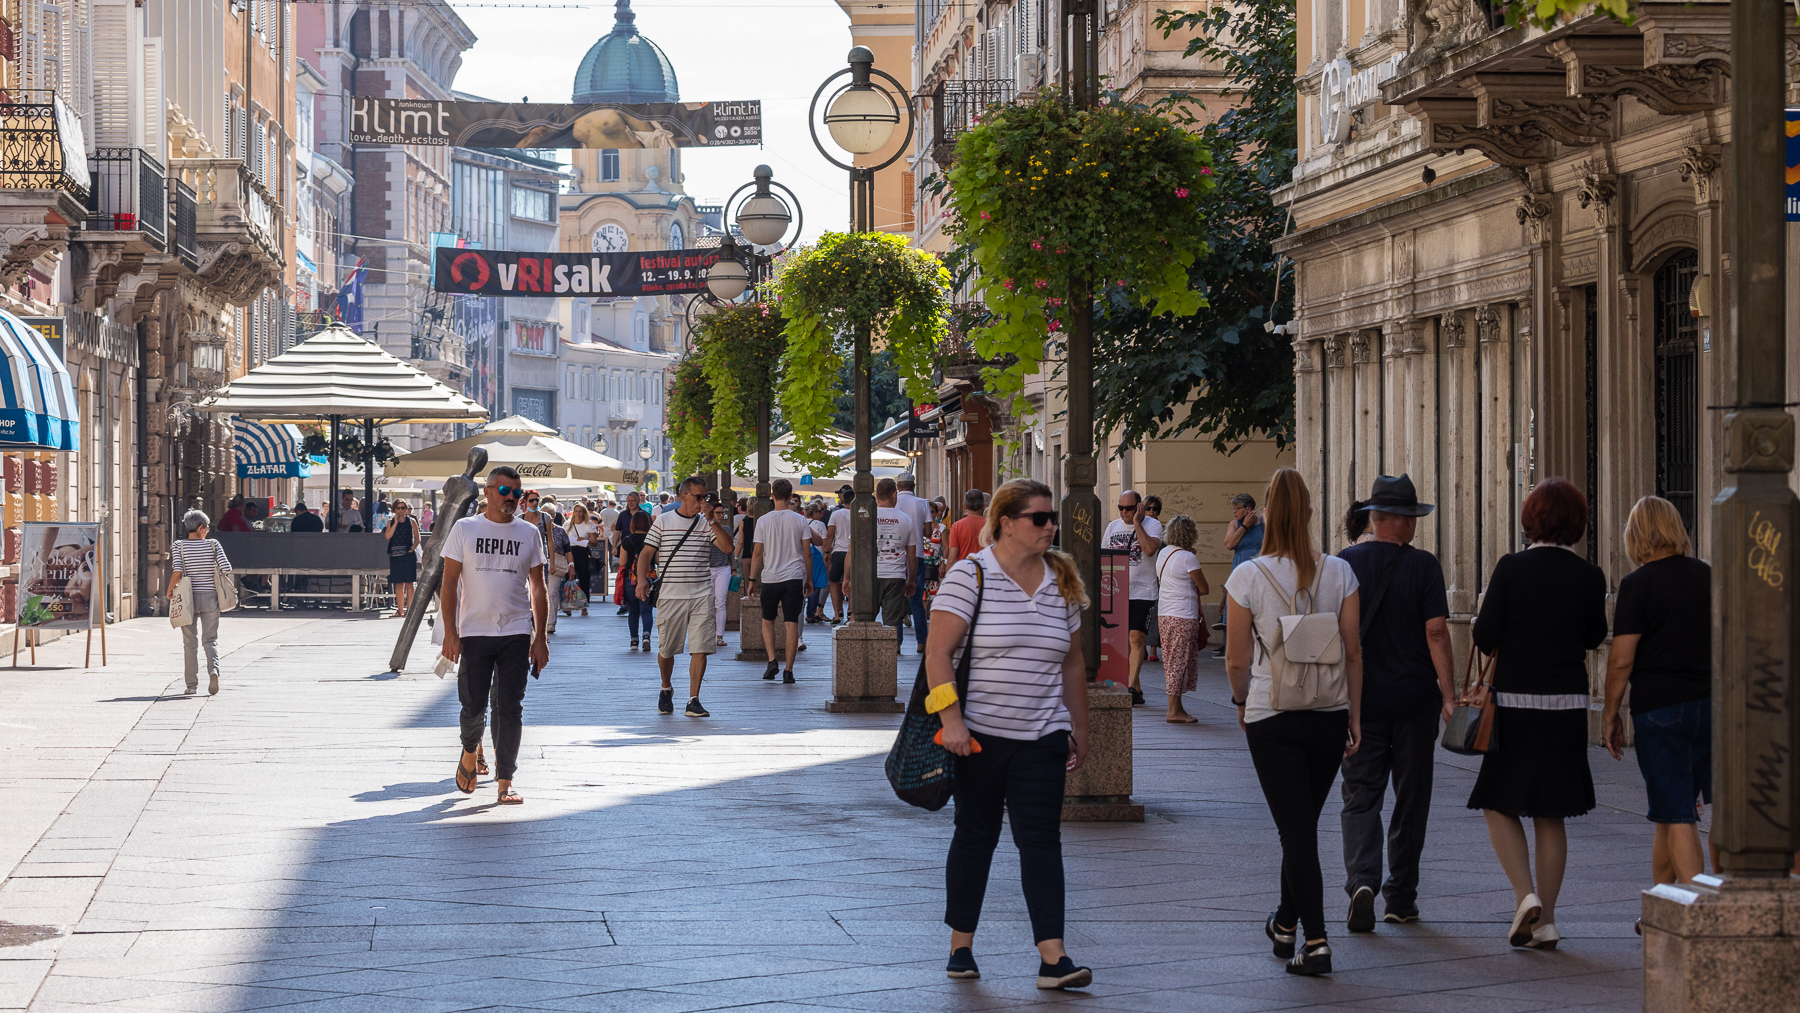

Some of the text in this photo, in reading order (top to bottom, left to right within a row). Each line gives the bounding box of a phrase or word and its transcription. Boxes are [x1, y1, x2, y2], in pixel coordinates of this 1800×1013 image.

[713, 102, 760, 116] klimt.hr
[640, 254, 681, 270] festival
[641, 271, 656, 282] 12.
[667, 269, 682, 281] 19.
[684, 269, 693, 280] 9.
[247, 464, 287, 475] ZLATAR
[476, 537, 520, 556] REPLAY
[30, 549, 81, 566] Kokos
